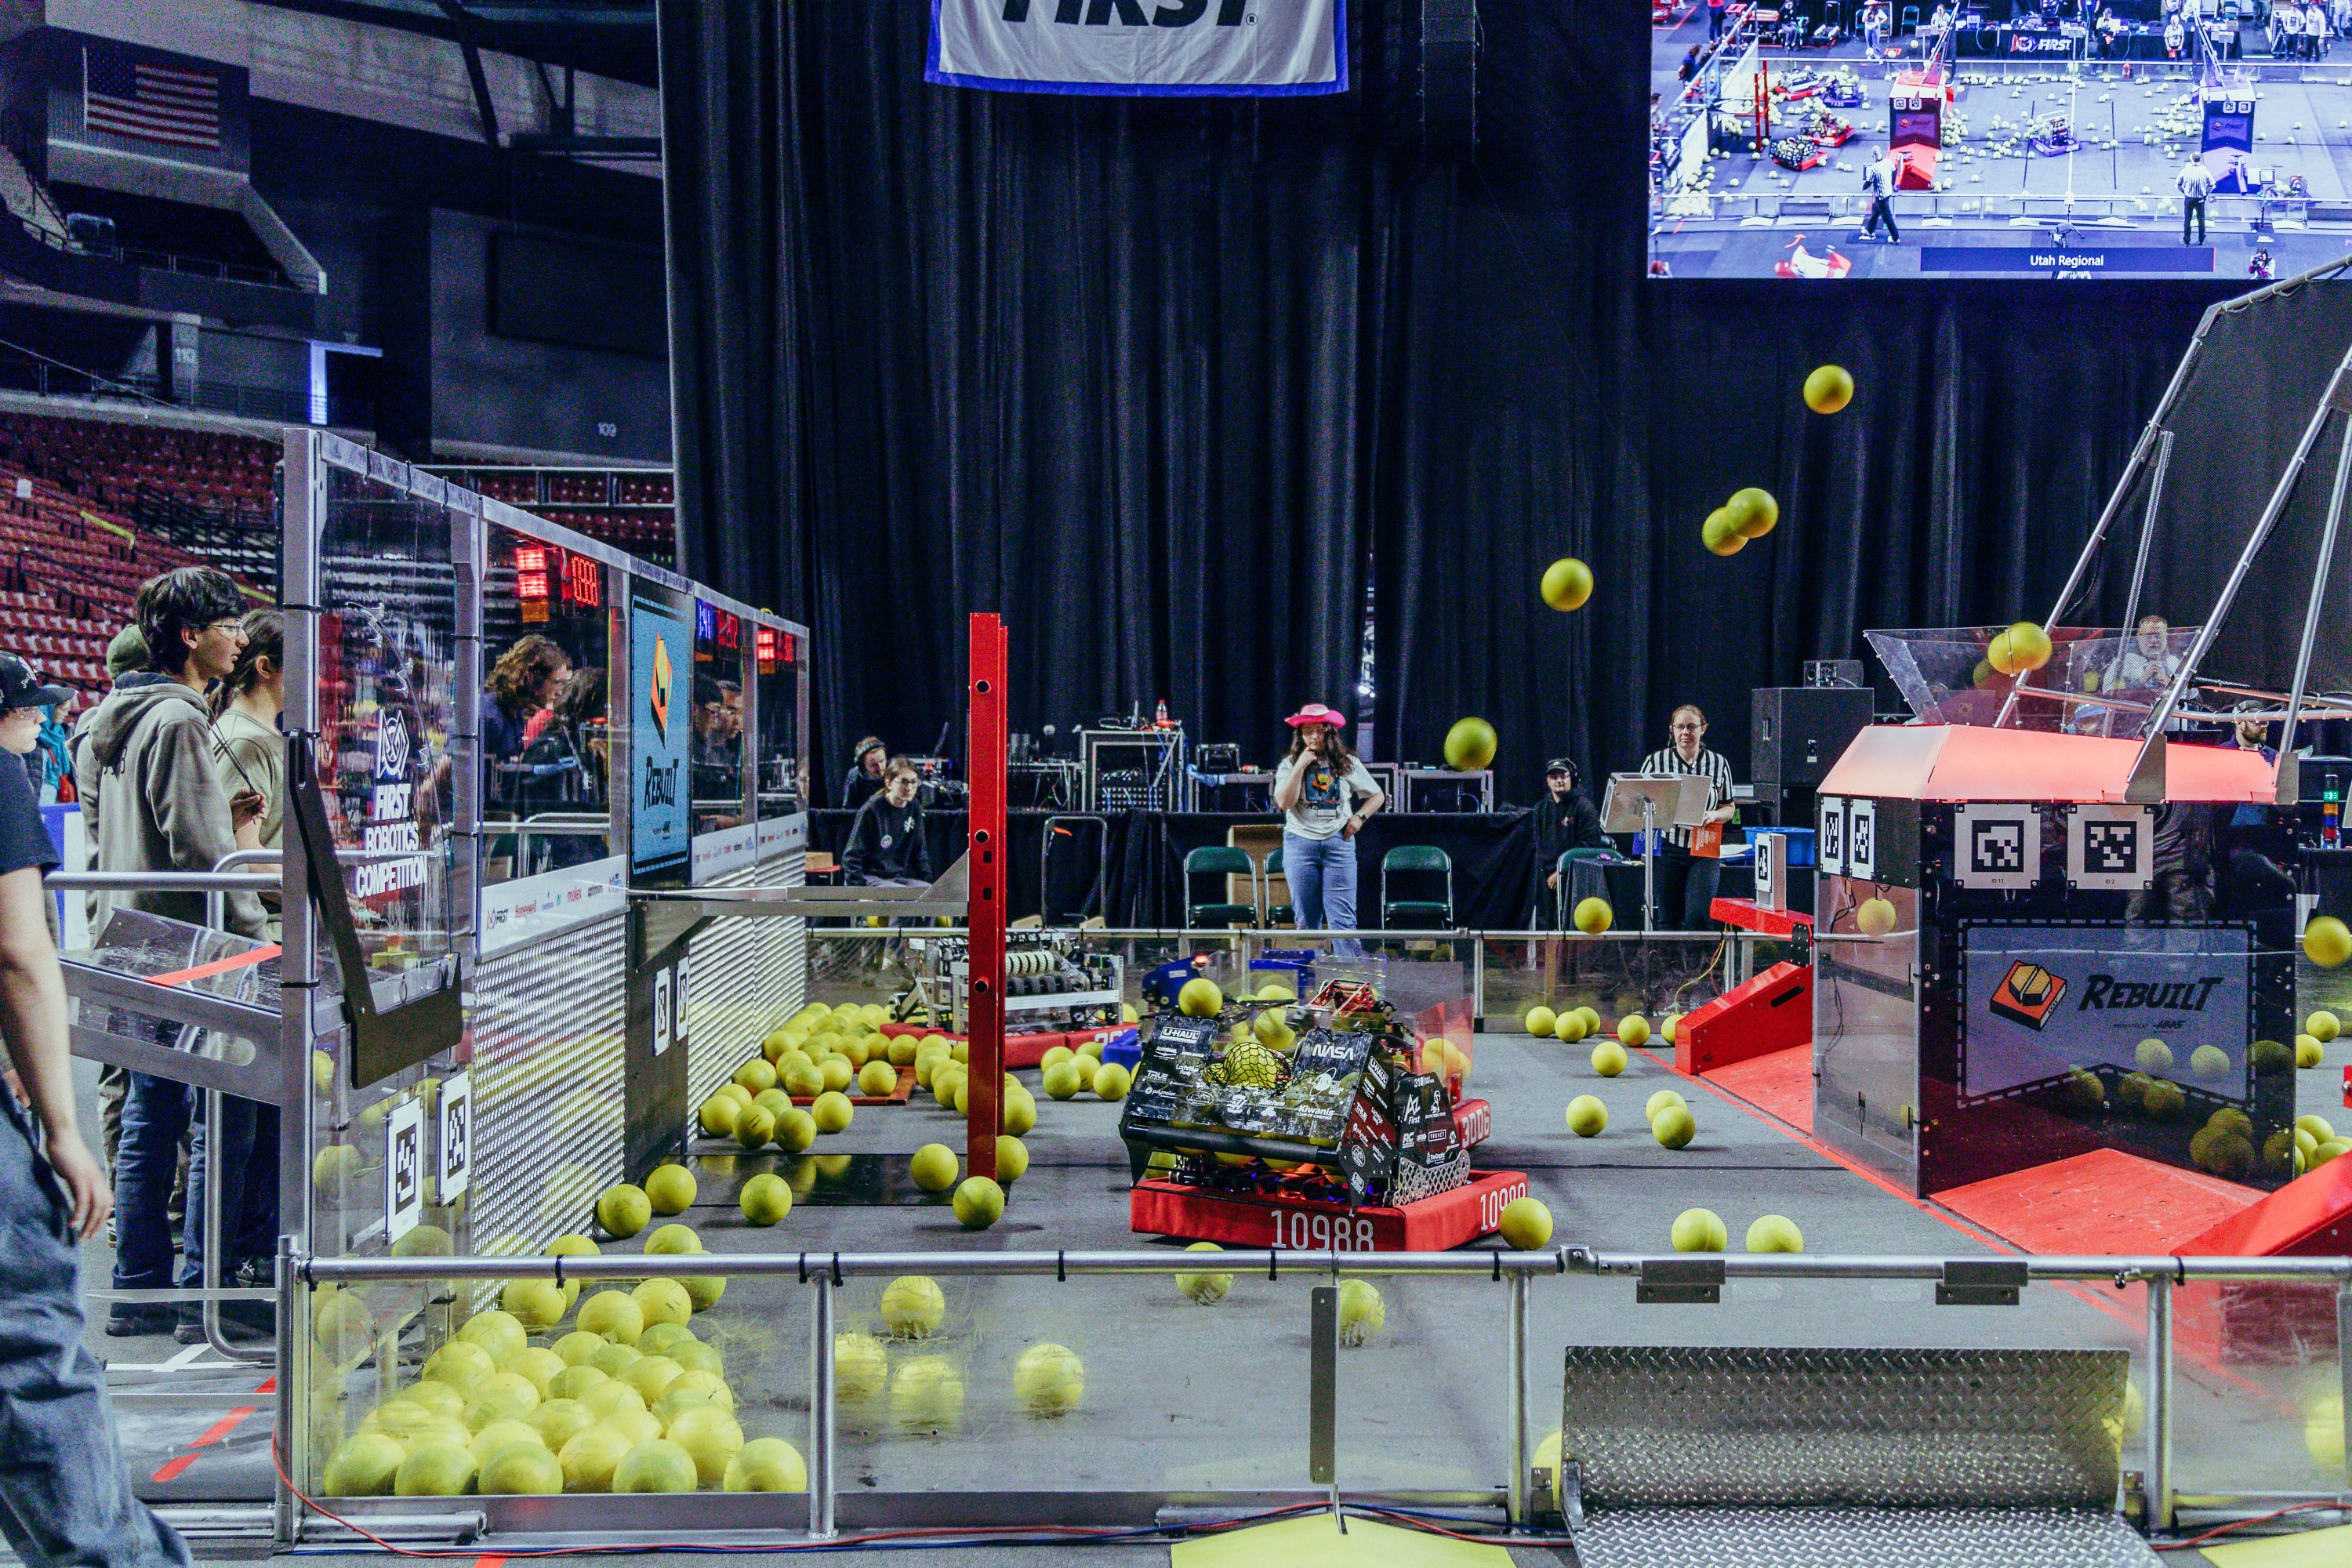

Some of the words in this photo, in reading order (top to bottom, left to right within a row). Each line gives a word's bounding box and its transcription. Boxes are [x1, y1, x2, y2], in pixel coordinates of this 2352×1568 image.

[2038, 38, 2072, 51] FIRST
[2030, 254, 2056, 266] Utah
[2058, 254, 2104, 269] Regional
[374, 783, 412, 821] FIRST
[365, 821, 419, 858] ROBOTICS
[356, 855, 428, 898] COMPETITION
[514, 899, 537, 919] Honeywell
[567, 885, 582, 903] molex
[2078, 974, 2225, 1012] REBUILT
[1162, 1028, 1199, 1040] U-HAUL
[1312, 1044, 1354, 1061] NASA
[1146, 1069, 1169, 1080] TRUE
[1370, 1058, 1388, 1084] U-HAUL
[1152, 1088, 1177, 1097] polymaker
[1298, 1105, 1335, 1116] Kiwanis
[1408, 1115, 1421, 1125] First
[1461, 1105, 1490, 1149] 3006
[1271, 1210, 1374, 1252] 10988
